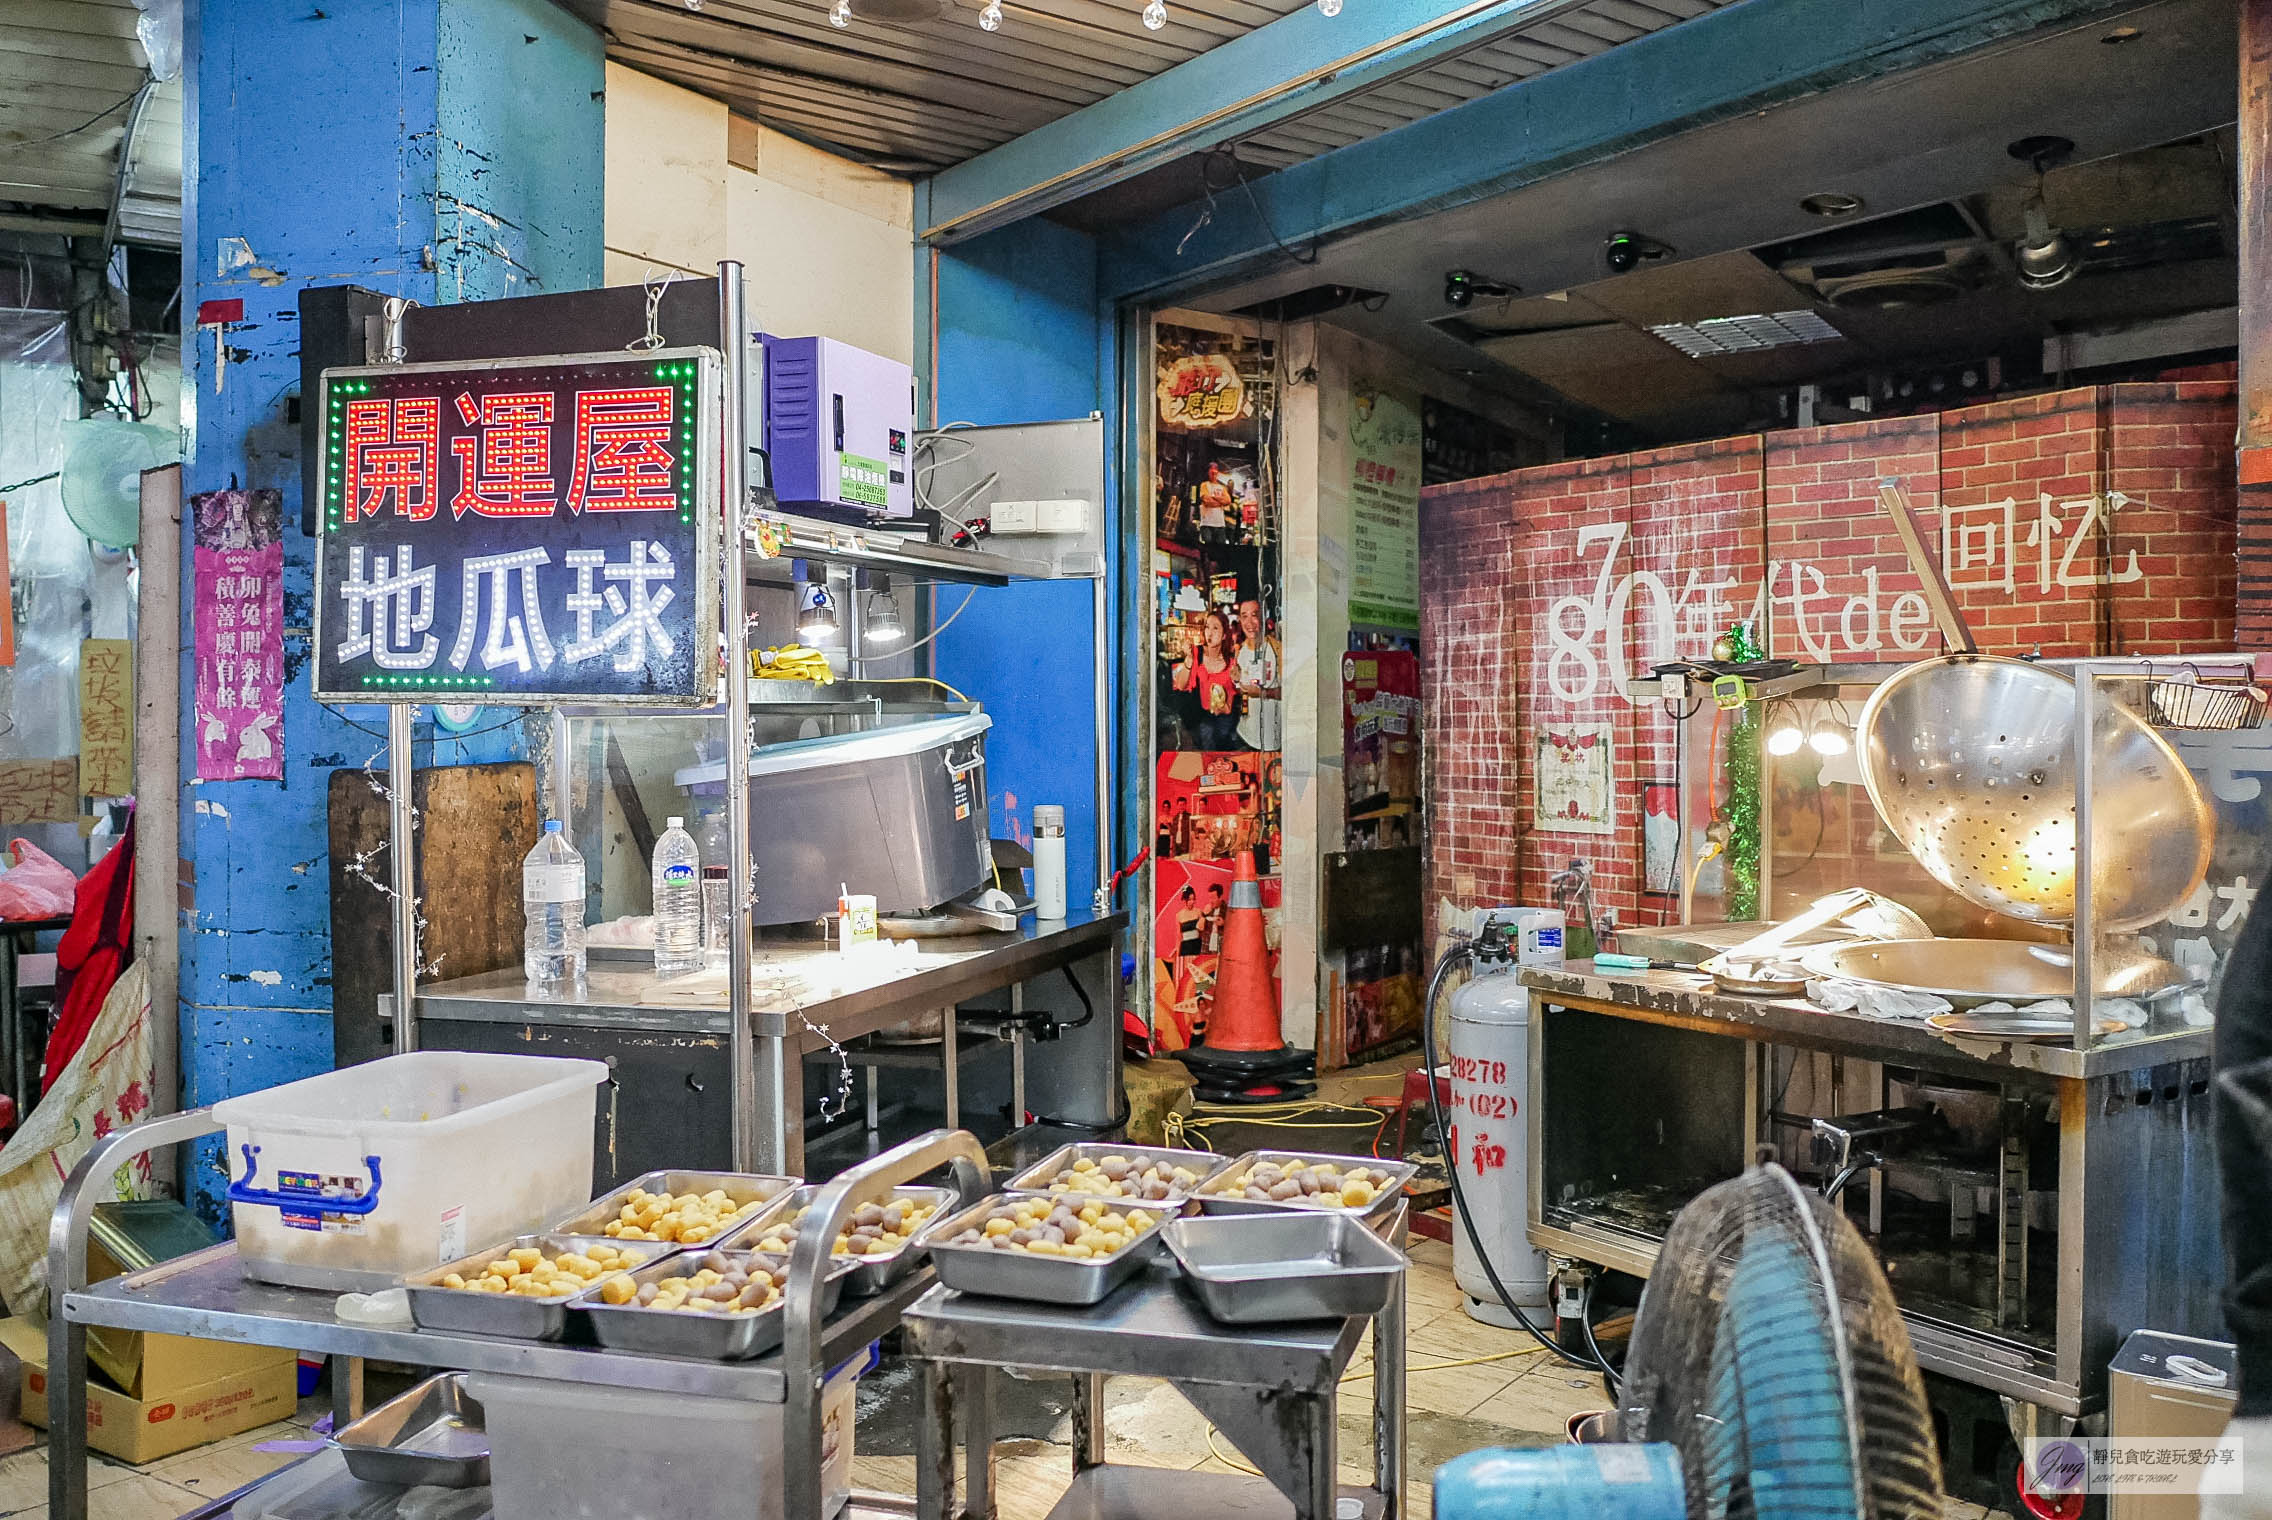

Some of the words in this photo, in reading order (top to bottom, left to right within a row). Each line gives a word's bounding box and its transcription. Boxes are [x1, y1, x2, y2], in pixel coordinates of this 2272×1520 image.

[344, 386, 676, 523] 開運屋
[337, 541, 676, 672] 地瓜球
